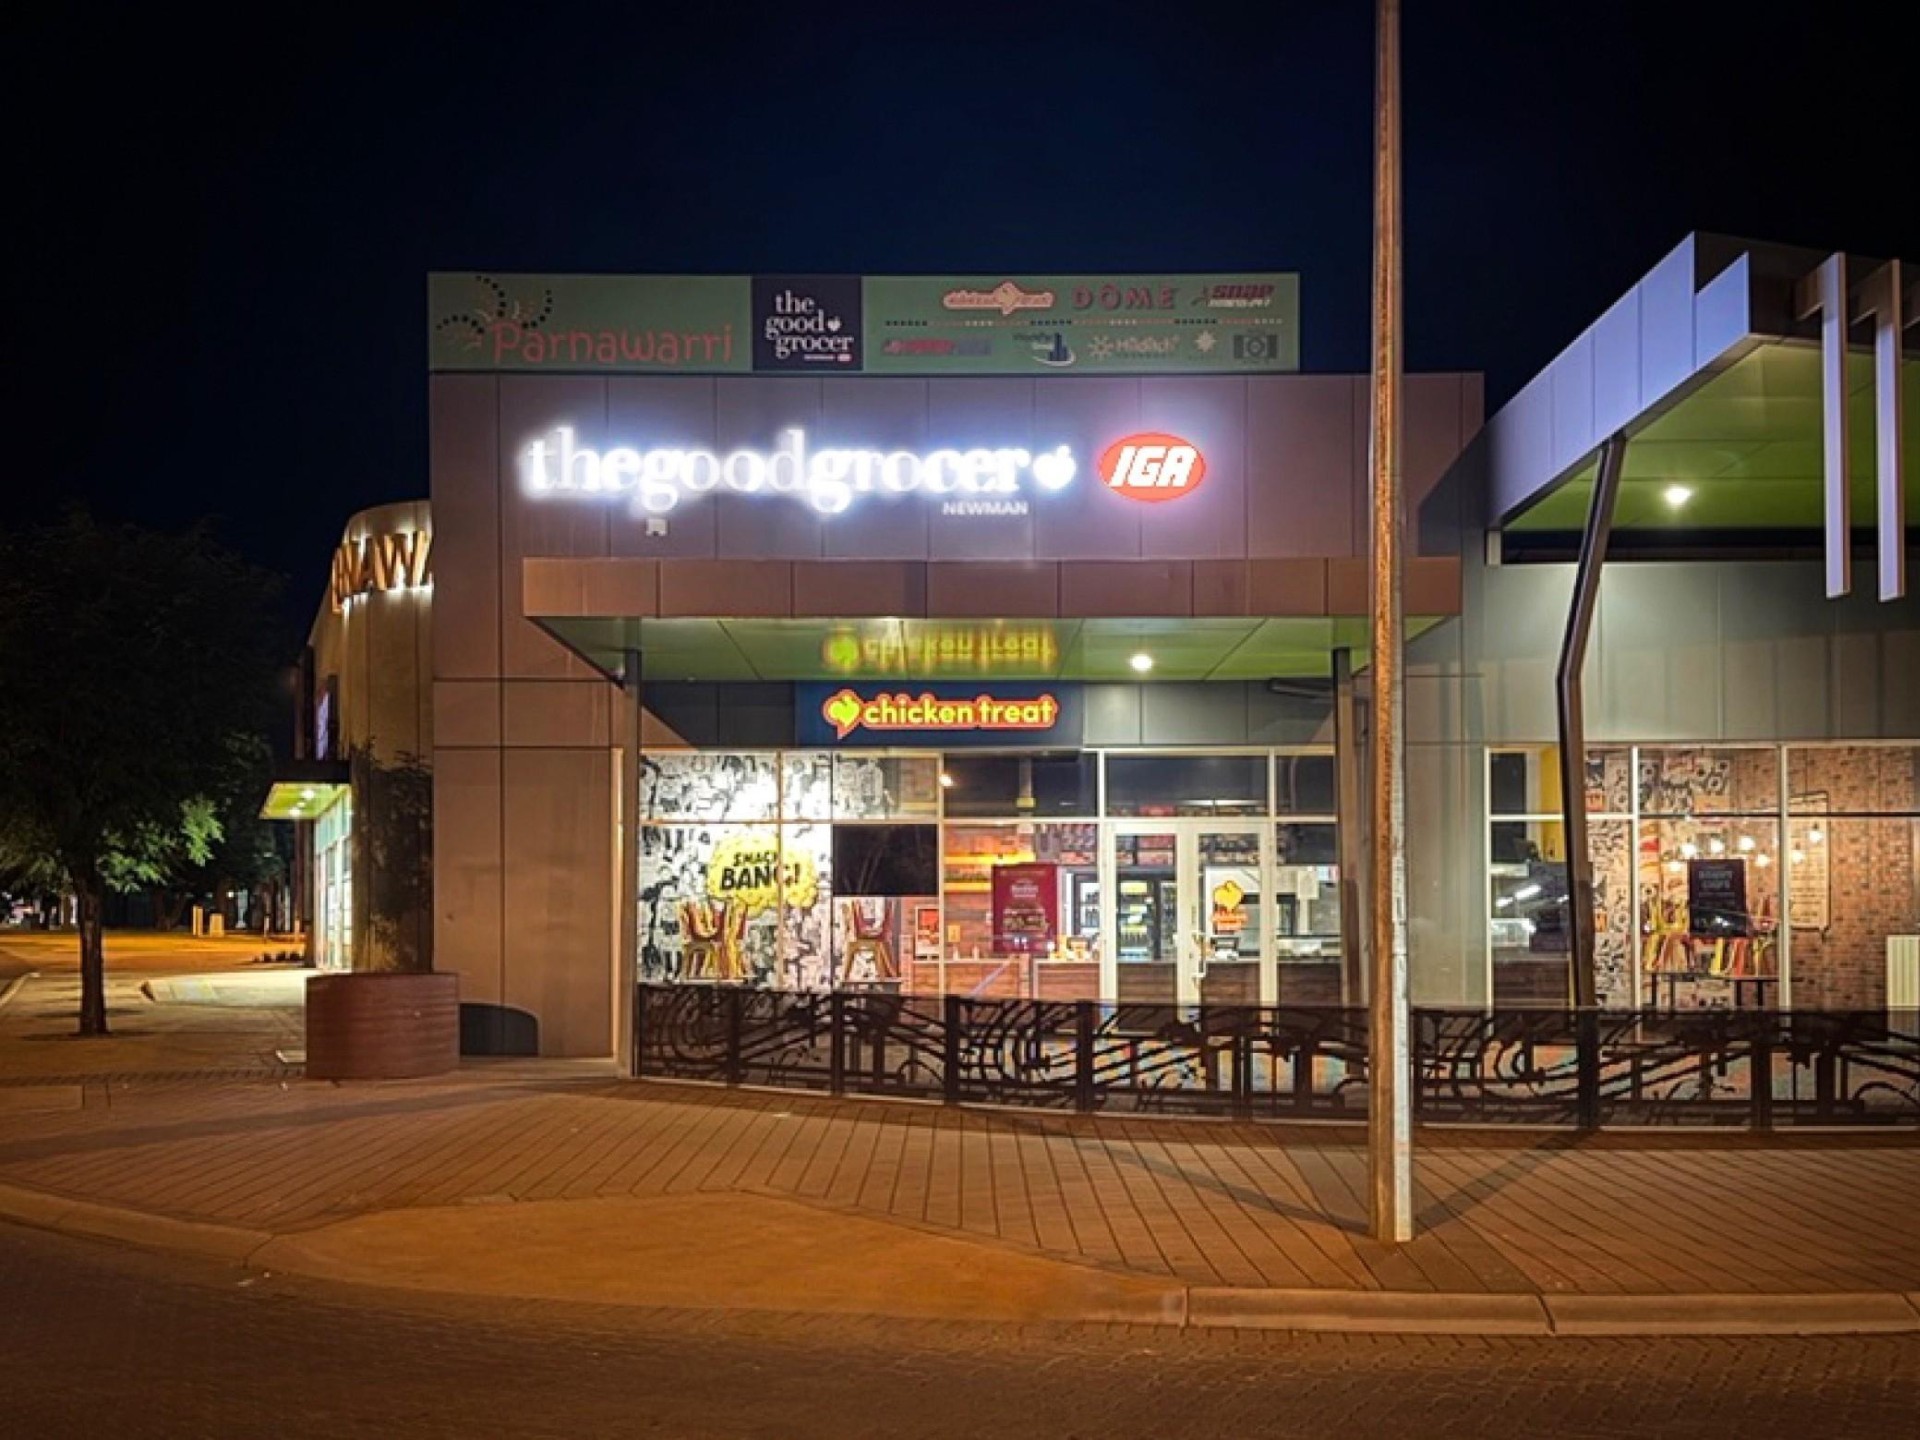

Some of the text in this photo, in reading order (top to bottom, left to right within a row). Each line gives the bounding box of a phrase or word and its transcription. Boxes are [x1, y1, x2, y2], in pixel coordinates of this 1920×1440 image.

[775, 290, 815, 313] the
[765, 309, 825, 340] good
[493, 321, 732, 364] Parnawarri
[775, 336, 854, 359] grocer
[525, 427, 1030, 512] thegoodgrocer
[1111, 445, 1196, 488] IGA
[942, 501, 1028, 515] NEWMAN
[864, 698, 1053, 723] chicken treat
[720, 863, 801, 890] BANG!
